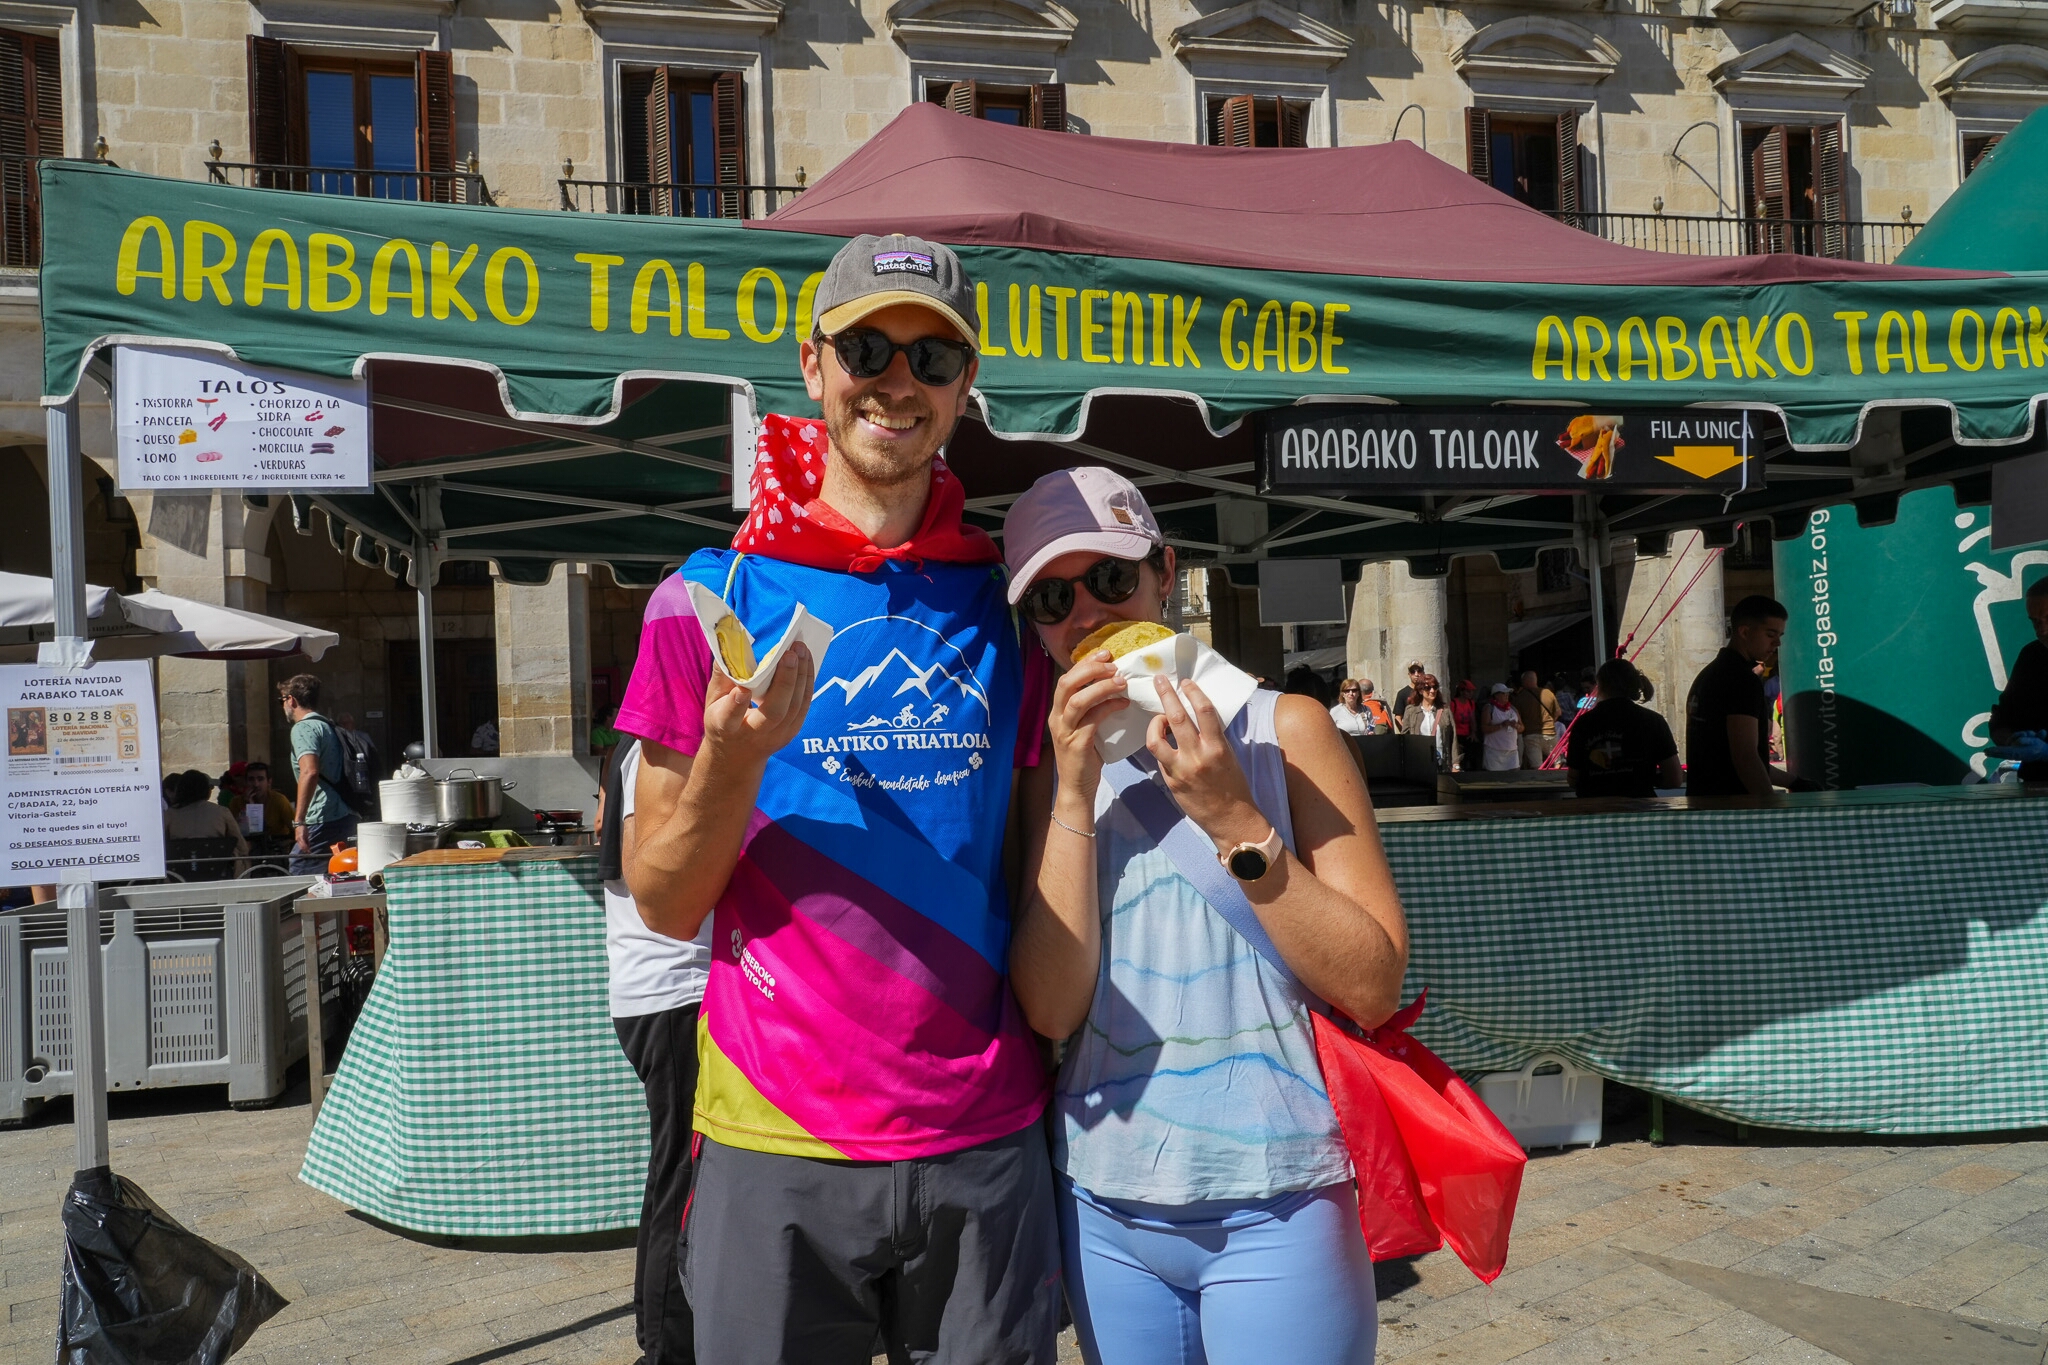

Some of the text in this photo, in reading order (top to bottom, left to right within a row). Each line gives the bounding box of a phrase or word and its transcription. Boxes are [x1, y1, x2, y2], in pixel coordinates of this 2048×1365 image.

[876, 262, 932, 273] patagonia
[116, 215, 1351, 374] ARABAKO TALO LUTENIK GABE
[1532, 312, 1814, 381] ARABAKO
[199, 379, 287, 395] TALOS
[259, 398, 340, 409] CHORIZO A LA
[142, 416, 193, 427] PANCETA
[257, 411, 291, 422] SIDRA
[259, 426, 314, 438] CHOCOLATE
[1650, 420, 1754, 440] FILA UNICA
[143, 434, 176, 445] QUESO
[259, 443, 305, 454] MORCILLA
[1281, 428, 1540, 469] ARABAKO TALOAK
[144, 453, 177, 464] LOMO
[260, 460, 306, 470] VERDURAS
[142, 474, 161, 482] TALO
[24, 676, 122, 687] LOTERÍA NAVIDAD
[20, 688, 124, 700] ARABAKO TALOAK
[124, 744, 134, 752] 20
[802, 733, 991, 754] IRATIKO TRIATLOIA
[8, 788, 92, 798] ADMINISTRACIÓN
[94, 785, 132, 794] LOTERÍA
[78, 798, 98, 806] bajo
[8, 810, 77, 820] Vitoria-Gasteiz
[49, 824, 80, 833] quedes
[82, 823, 95, 831] sin
[106, 821, 128, 830] tuyo!
[9, 835, 140, 849] OS DESEAMOS BUENA SUERTE!
[11, 853, 140, 870] SOLO VENTA DÉCIMOS
